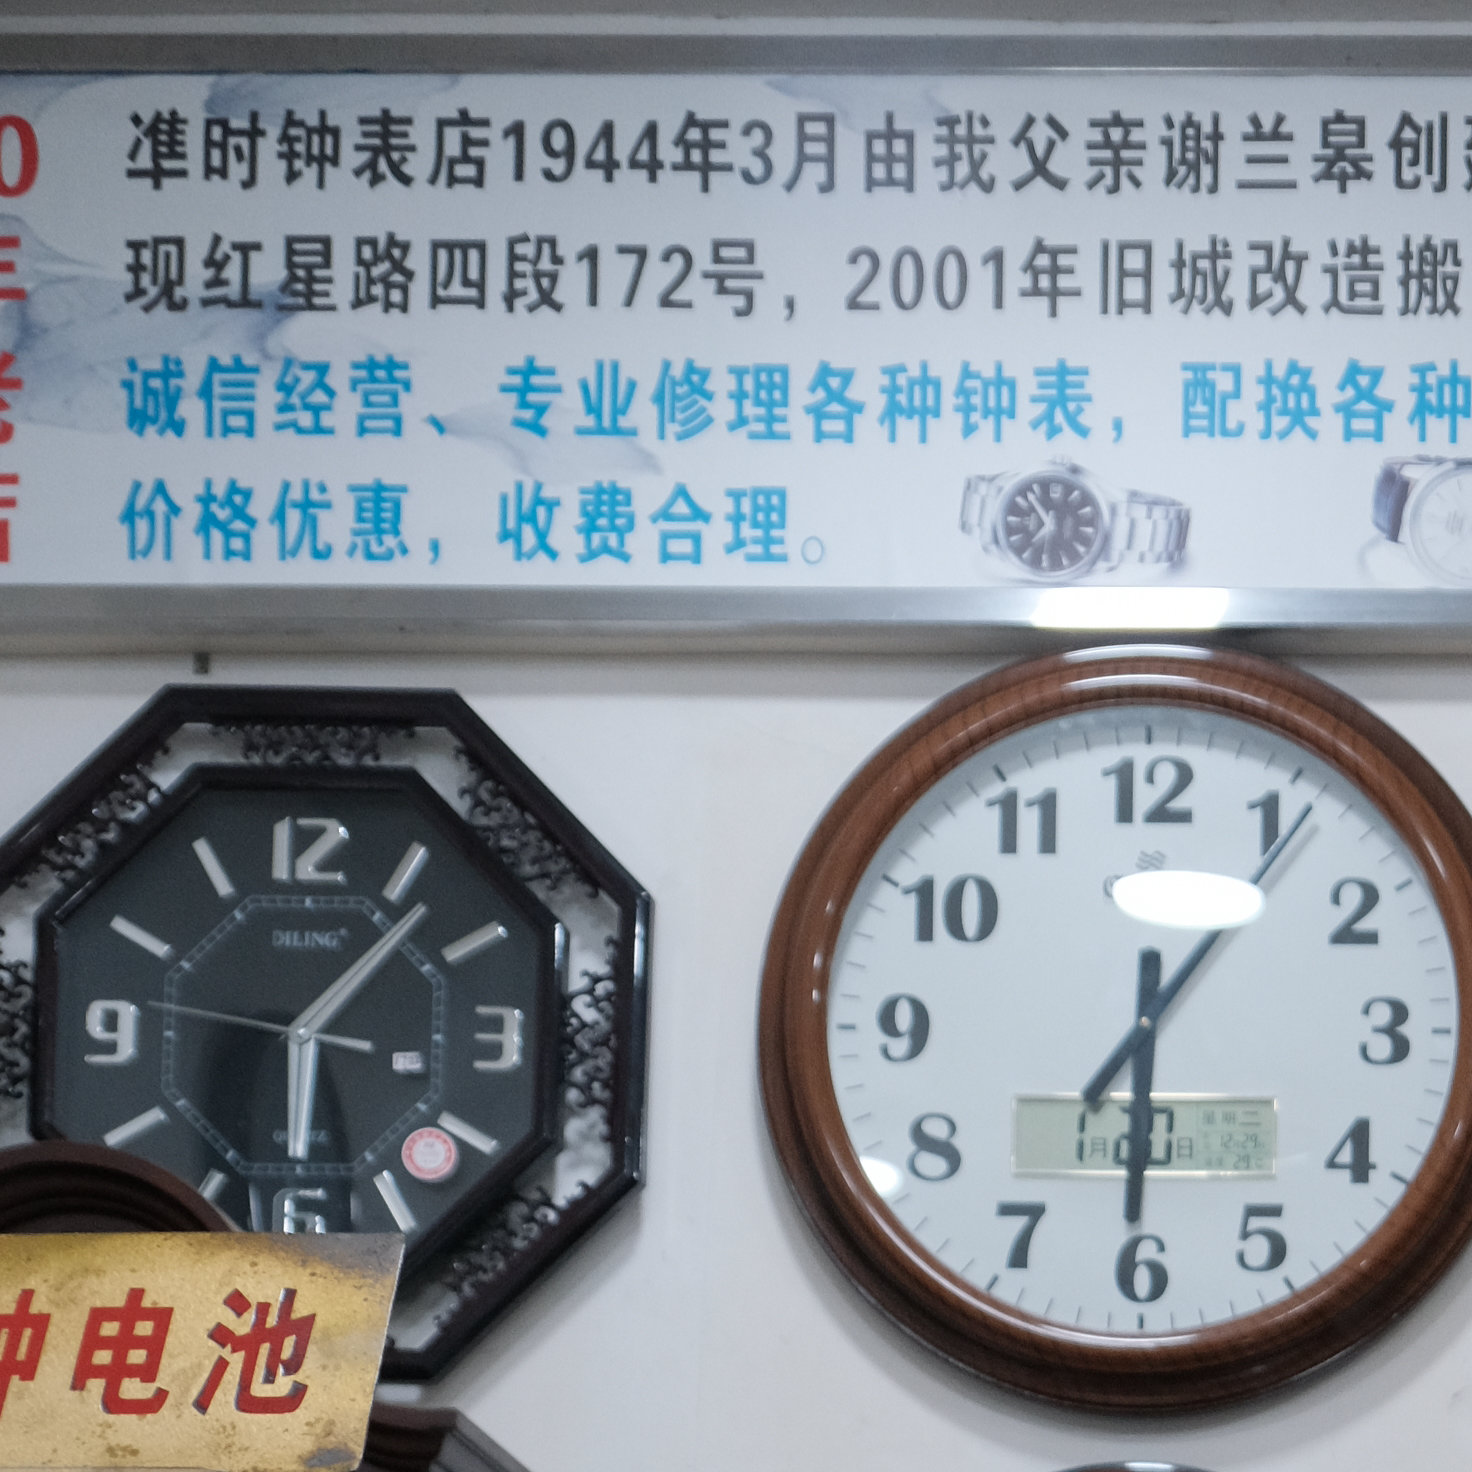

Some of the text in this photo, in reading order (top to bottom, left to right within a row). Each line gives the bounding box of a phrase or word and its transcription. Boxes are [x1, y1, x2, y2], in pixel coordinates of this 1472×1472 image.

[119, 476, 826, 567] 价格优惠，收费合理。
[985, 787, 1058, 854] 11
[1102, 756, 1195, 824] 12
[1247, 789, 1282, 856] 1
[272, 818, 348, 885] 12
[901, 873, 999, 943] 10
[1328, 877, 1381, 945] 2
[84, 1000, 141, 1066] 9
[473, 1005, 524, 1071] 3
[876, 993, 930, 1061] 9
[1359, 996, 1412, 1065] 3
[907, 1112, 962, 1181] 8
[1325, 1117, 1378, 1185] 4
[996, 1203, 1046, 1270] 7
[1115, 1233, 1168, 1303] 6
[1235, 1204, 1287, 1272] 5
